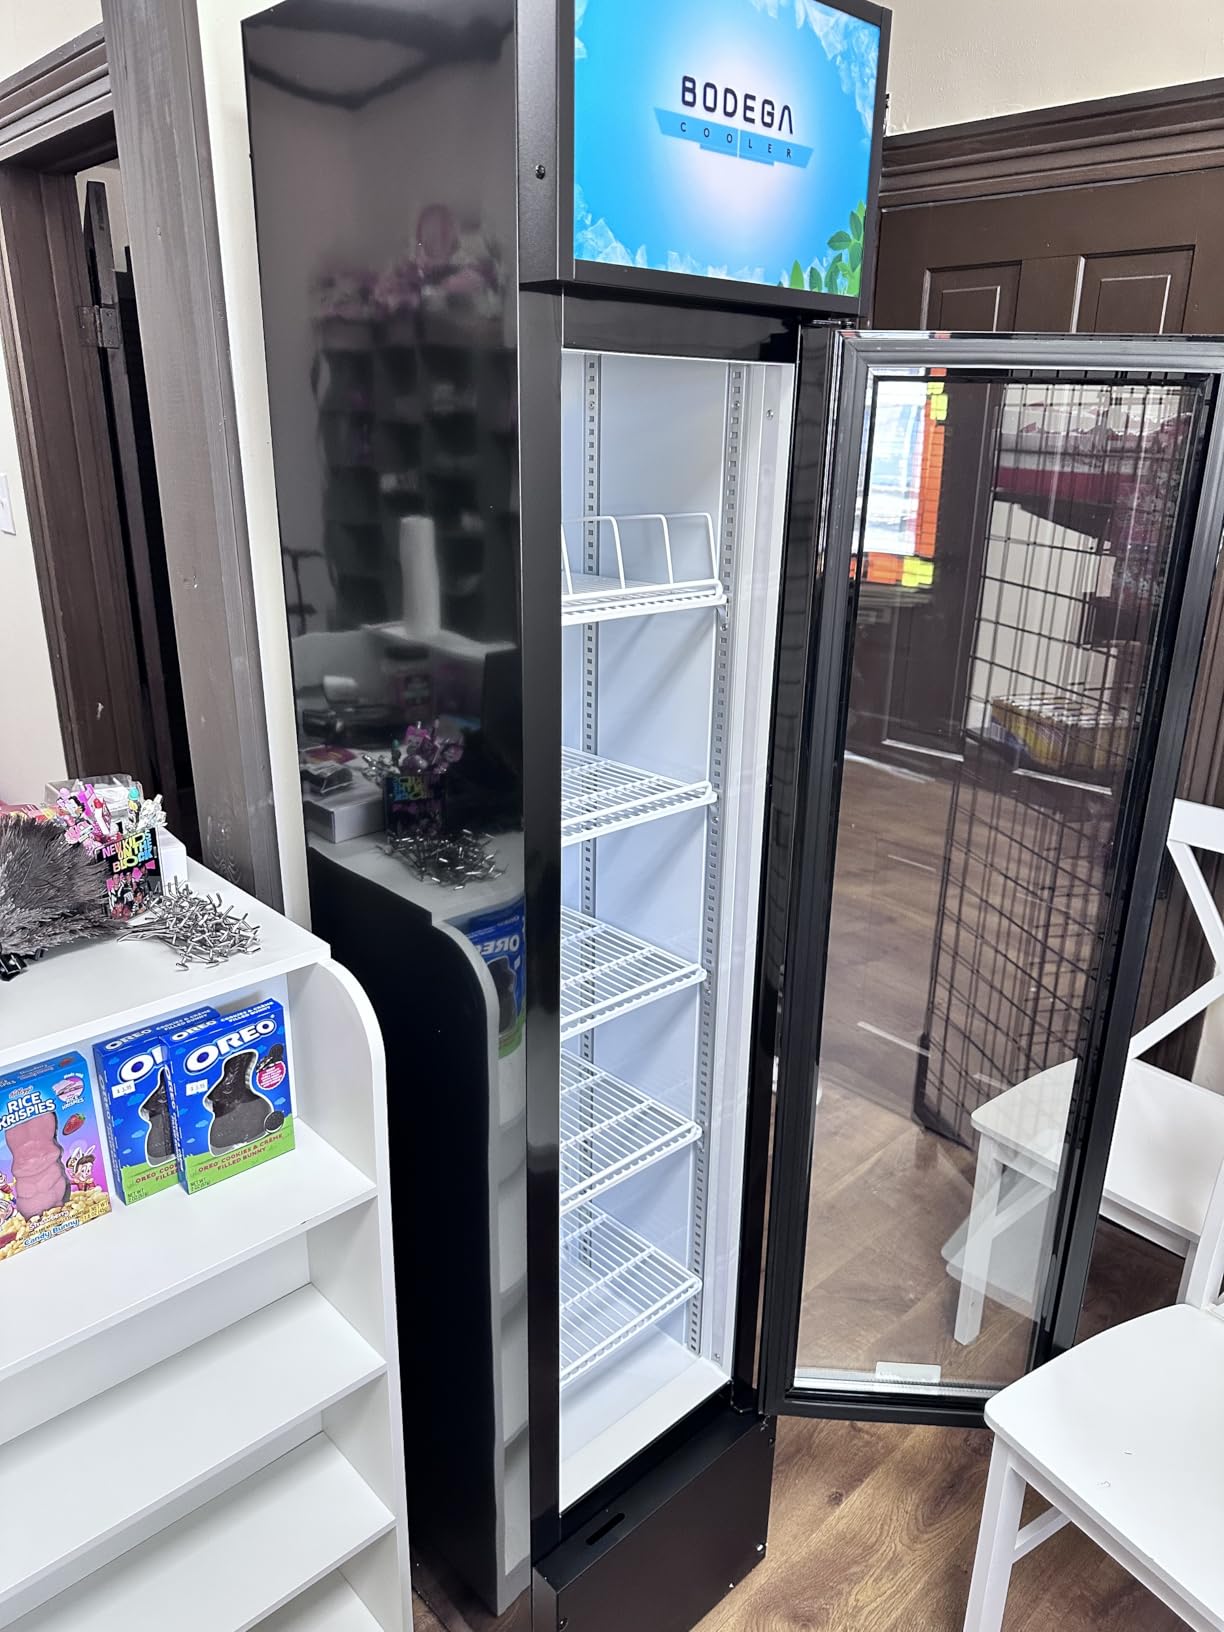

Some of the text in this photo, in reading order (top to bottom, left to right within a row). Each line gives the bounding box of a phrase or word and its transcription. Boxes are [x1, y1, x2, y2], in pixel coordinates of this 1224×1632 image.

[681, 75, 794, 135] BODEGA
[680, 121, 792, 159] COOLER
[101, 840, 122, 859] NEW
[112, 849, 153, 873] BLOCK
[105, 1029, 152, 1050] OREO
[171, 1020, 217, 1042] OREO
[185, 1019, 276, 1072] OREO
[8, 1091, 41, 1114] RICE
[0, 1099, 56, 1131] KRISPIES
[198, 1162, 219, 1173] OREO
[221, 1149, 250, 1163] COOKIES
[217, 1148, 267, 1172] FILLED BUNNY
[135, 1168, 157, 1184] OREO
[24, 1230, 52, 1247] Candy
[52, 1219, 80, 1236] Bunny
